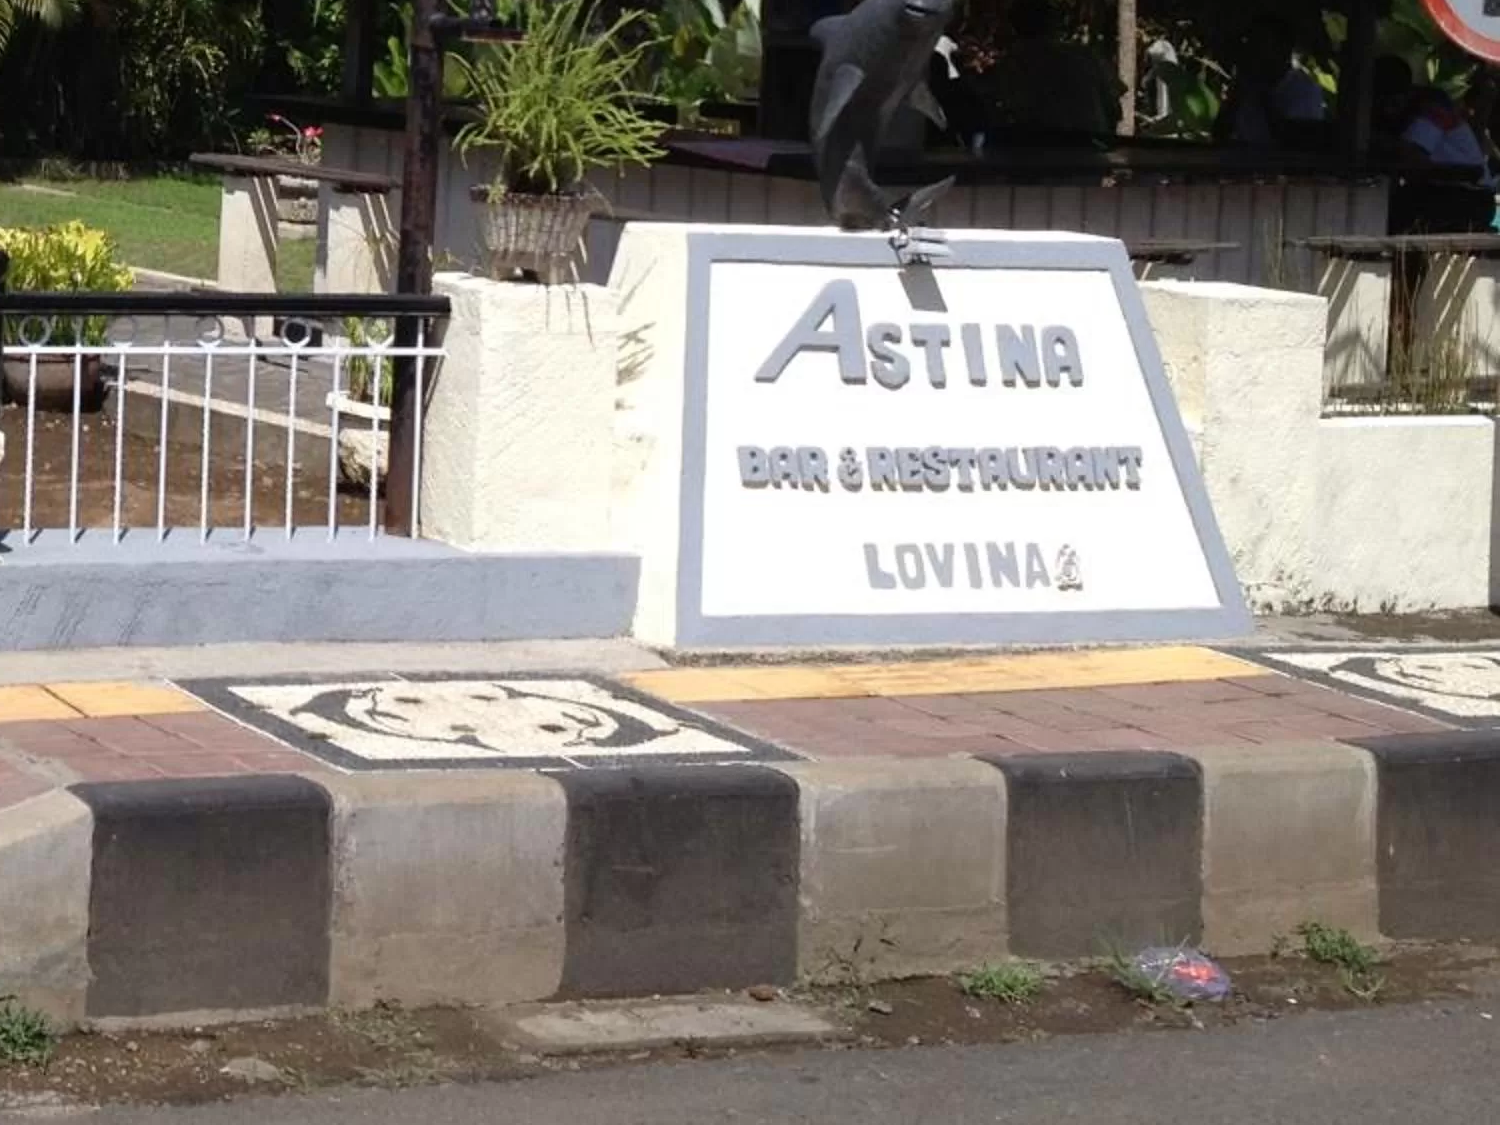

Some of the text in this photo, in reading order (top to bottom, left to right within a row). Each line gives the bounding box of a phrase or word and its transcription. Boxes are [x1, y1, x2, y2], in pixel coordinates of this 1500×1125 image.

[754, 278, 1084, 391] ASTINA
[737, 445, 1144, 492] BAR & RESTAURANT
[863, 543, 1051, 590] LOVINA
